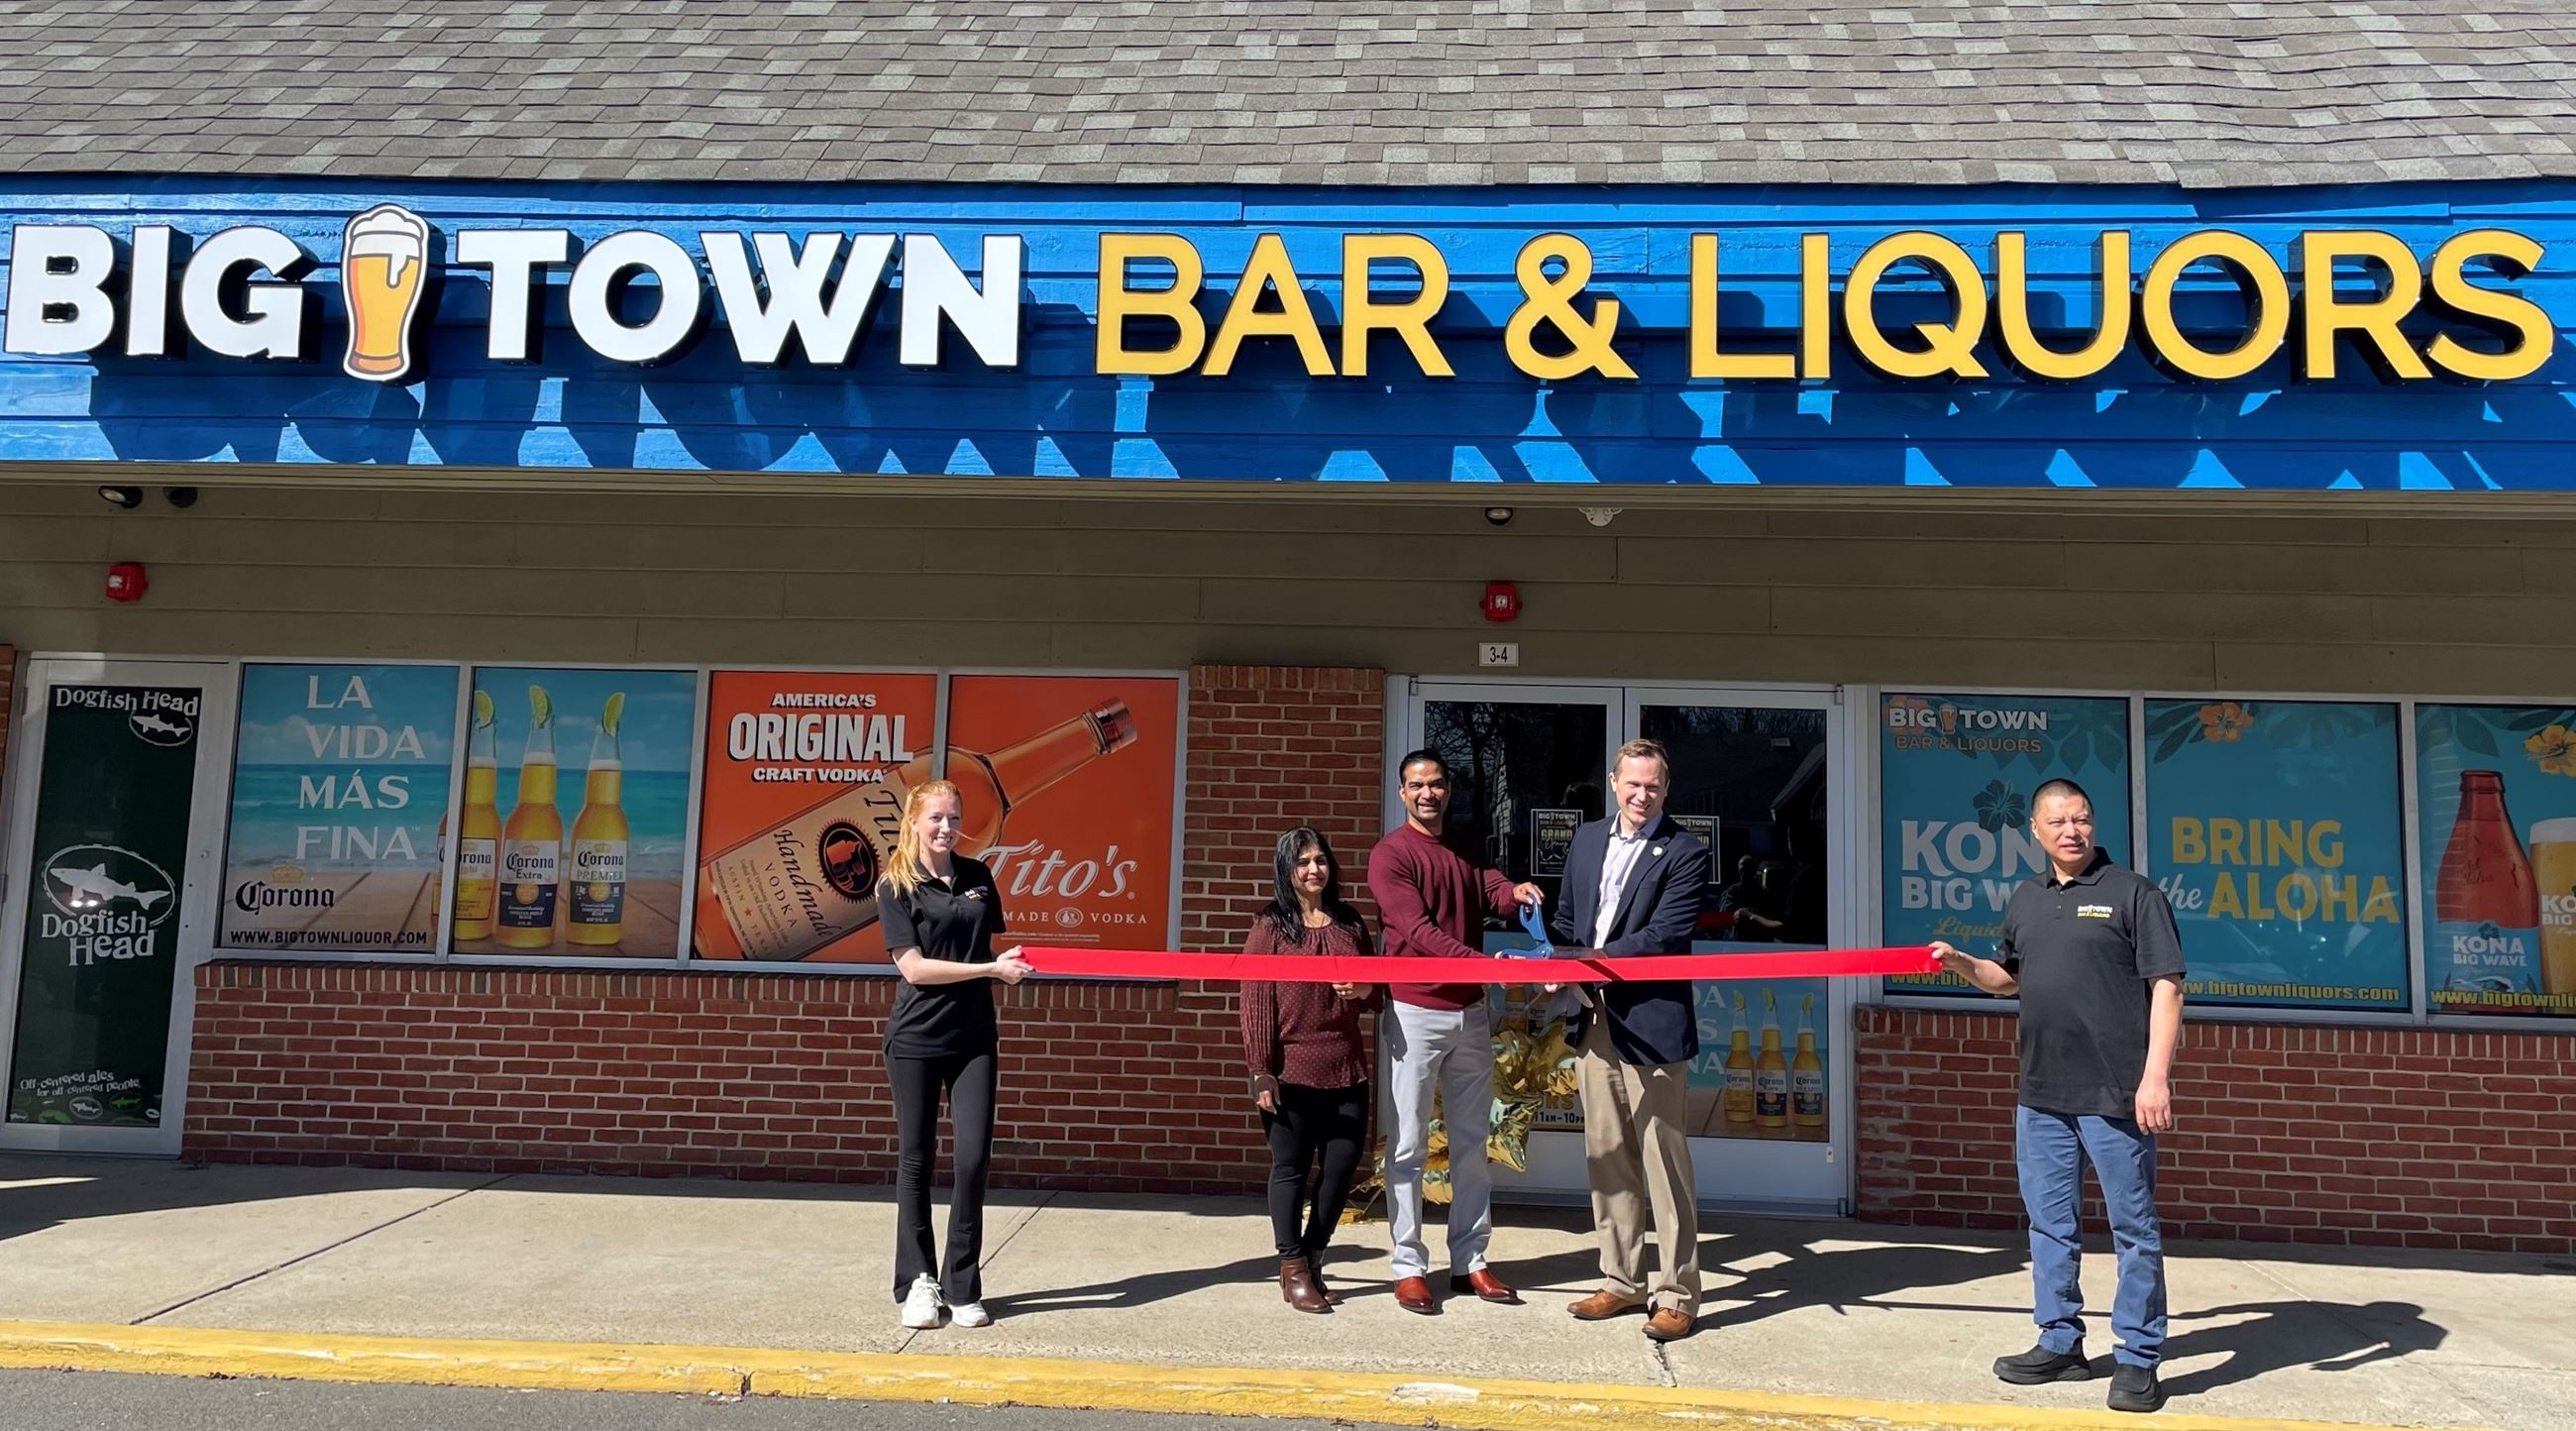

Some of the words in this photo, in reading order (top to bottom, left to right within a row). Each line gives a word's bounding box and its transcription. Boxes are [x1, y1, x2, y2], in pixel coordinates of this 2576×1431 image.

[4, 223, 307, 360] BIG
[457, 228, 1024, 367] TOWN
[1095, 231, 1456, 379] BAR
[1505, 236, 1638, 380] &
[1689, 228, 2556, 382] LIQUORS
[1489, 645, 1508, 663] 3-4
[55, 688, 138, 712] Dogfish
[142, 691, 199, 716] Head
[306, 675, 373, 710] LA
[772, 693, 878, 709] AMERICA'S
[1889, 708, 1936, 727] BIG
[1959, 710, 2047, 730] TOWN
[305, 724, 425, 760] VIDA
[728, 712, 914, 763] ORIGINAL
[1896, 736, 1932, 750] BAR
[1939, 736, 1950, 751] &
[1958, 737, 2041, 752] LIQUORS
[752, 767, 815, 782] CRAFT
[816, 768, 885, 784] VODKA
[298, 768, 410, 811] MÁS
[1541, 829, 1573, 841] GRAND
[2172, 817, 2343, 868] BRING
[578, 849, 625, 868] Corona
[1901, 820, 2046, 878] KON
[506, 852, 555, 871] Corona
[975, 838, 1137, 898] Tito's
[516, 869, 543, 880] Extra
[774, 829, 842, 936] Handmade
[235, 879, 336, 916] Corona
[765, 862, 798, 928] VODKA
[1901, 876, 1973, 911] BIG
[2206, 872, 2401, 925] ALOHA
[42, 909, 148, 938] Dogfish
[1003, 912, 1049, 922] MADE
[1090, 913, 1147, 924] VODKA
[2541, 914, 2573, 926] BIG
[69, 930, 156, 967] Head
[230, 930, 428, 945] WWW.BIGTOWNLIQUOR.COM
[2452, 936, 2525, 954] KONA
[2453, 953, 2479, 965] BIG
[2482, 954, 2527, 967] WAVE
[1692, 985, 1726, 1008] DA
[2183, 980, 2400, 1001] w.bigtownliquors.com
[1686, 1051, 1725, 1075] NA
[87, 1070, 115, 1084] ales
